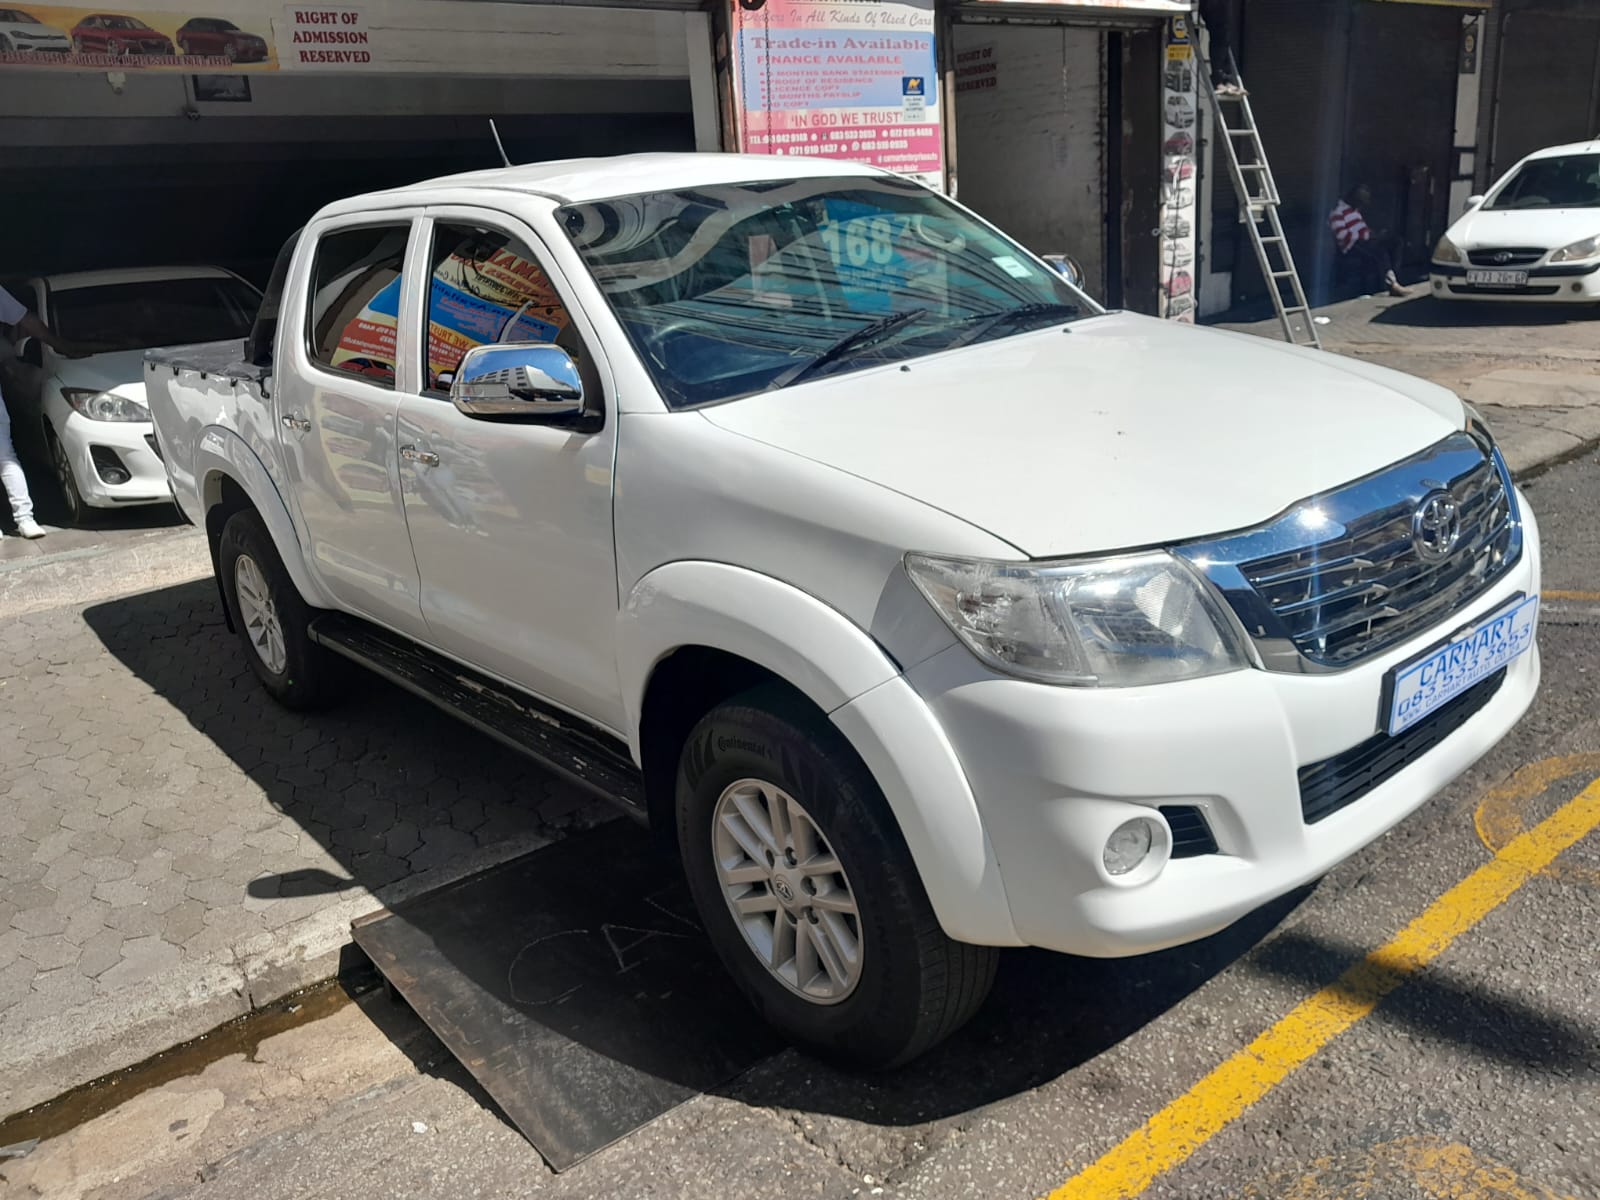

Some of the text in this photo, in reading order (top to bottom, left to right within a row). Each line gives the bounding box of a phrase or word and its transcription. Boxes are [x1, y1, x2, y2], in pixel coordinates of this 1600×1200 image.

[295, 11, 359, 25] RIGHT OF
[806, 10, 826, 23] All
[829, 10, 861, 24] Kinds
[864, 11, 877, 27] Of
[880, 11, 907, 25] Used
[909, 12, 932, 27] Cars
[293, 31, 368, 44] ADMISSION
[751, 36, 929, 50] Trade-in Available
[299, 50, 371, 63] RESERVED
[757, 55, 902, 65] FNANCE AVAILABLE
[812, 113, 837, 126] GOD
[841, 112, 859, 125] WE
[1420, 611, 1519, 687] CARMART
[1397, 622, 1530, 717] 083 533 3653
[718, 735, 766, 759] Continental
